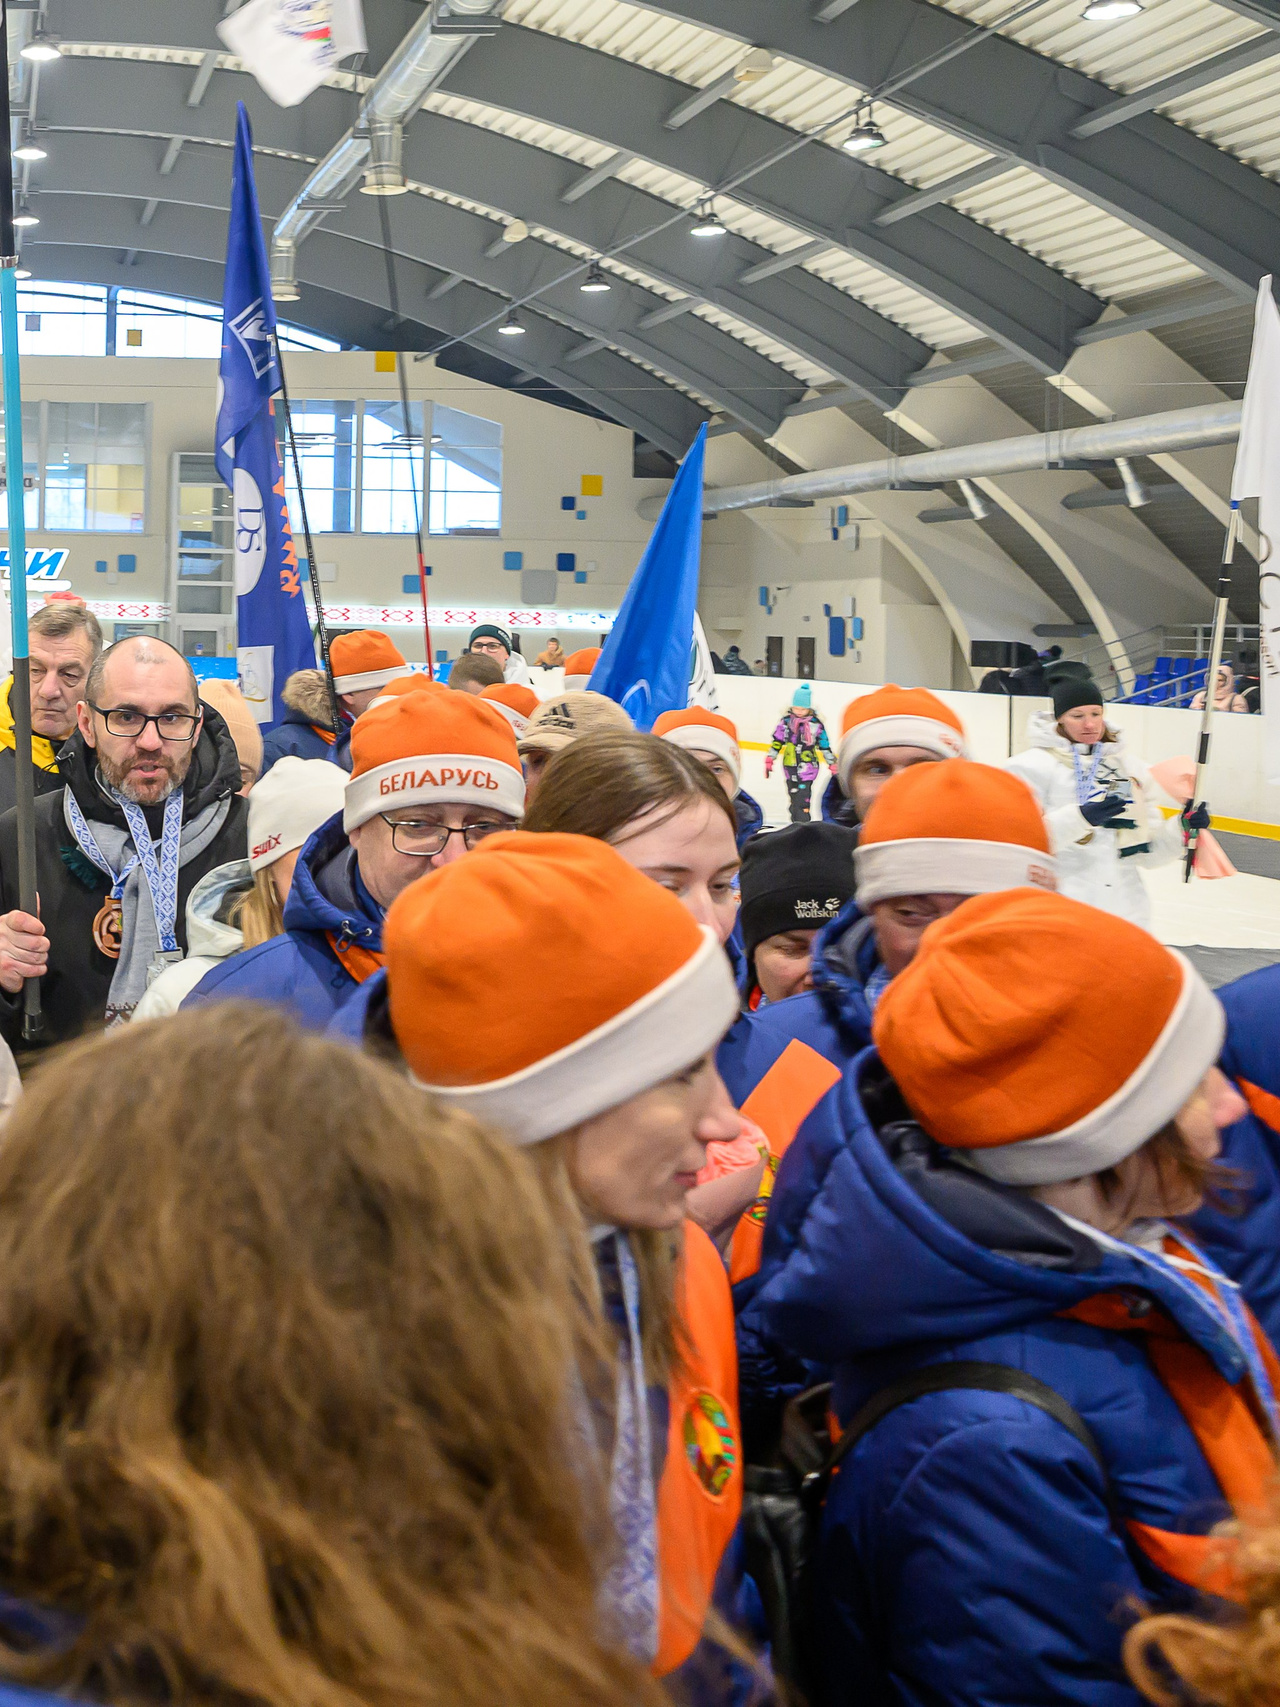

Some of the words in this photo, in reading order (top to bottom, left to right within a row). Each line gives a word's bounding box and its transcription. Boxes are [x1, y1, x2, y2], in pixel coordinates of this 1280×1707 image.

[379, 768, 500, 796] БЕЛАРУСЬ
[794, 899, 820, 908] Jack
[795, 908, 839, 918] Wolfskin
